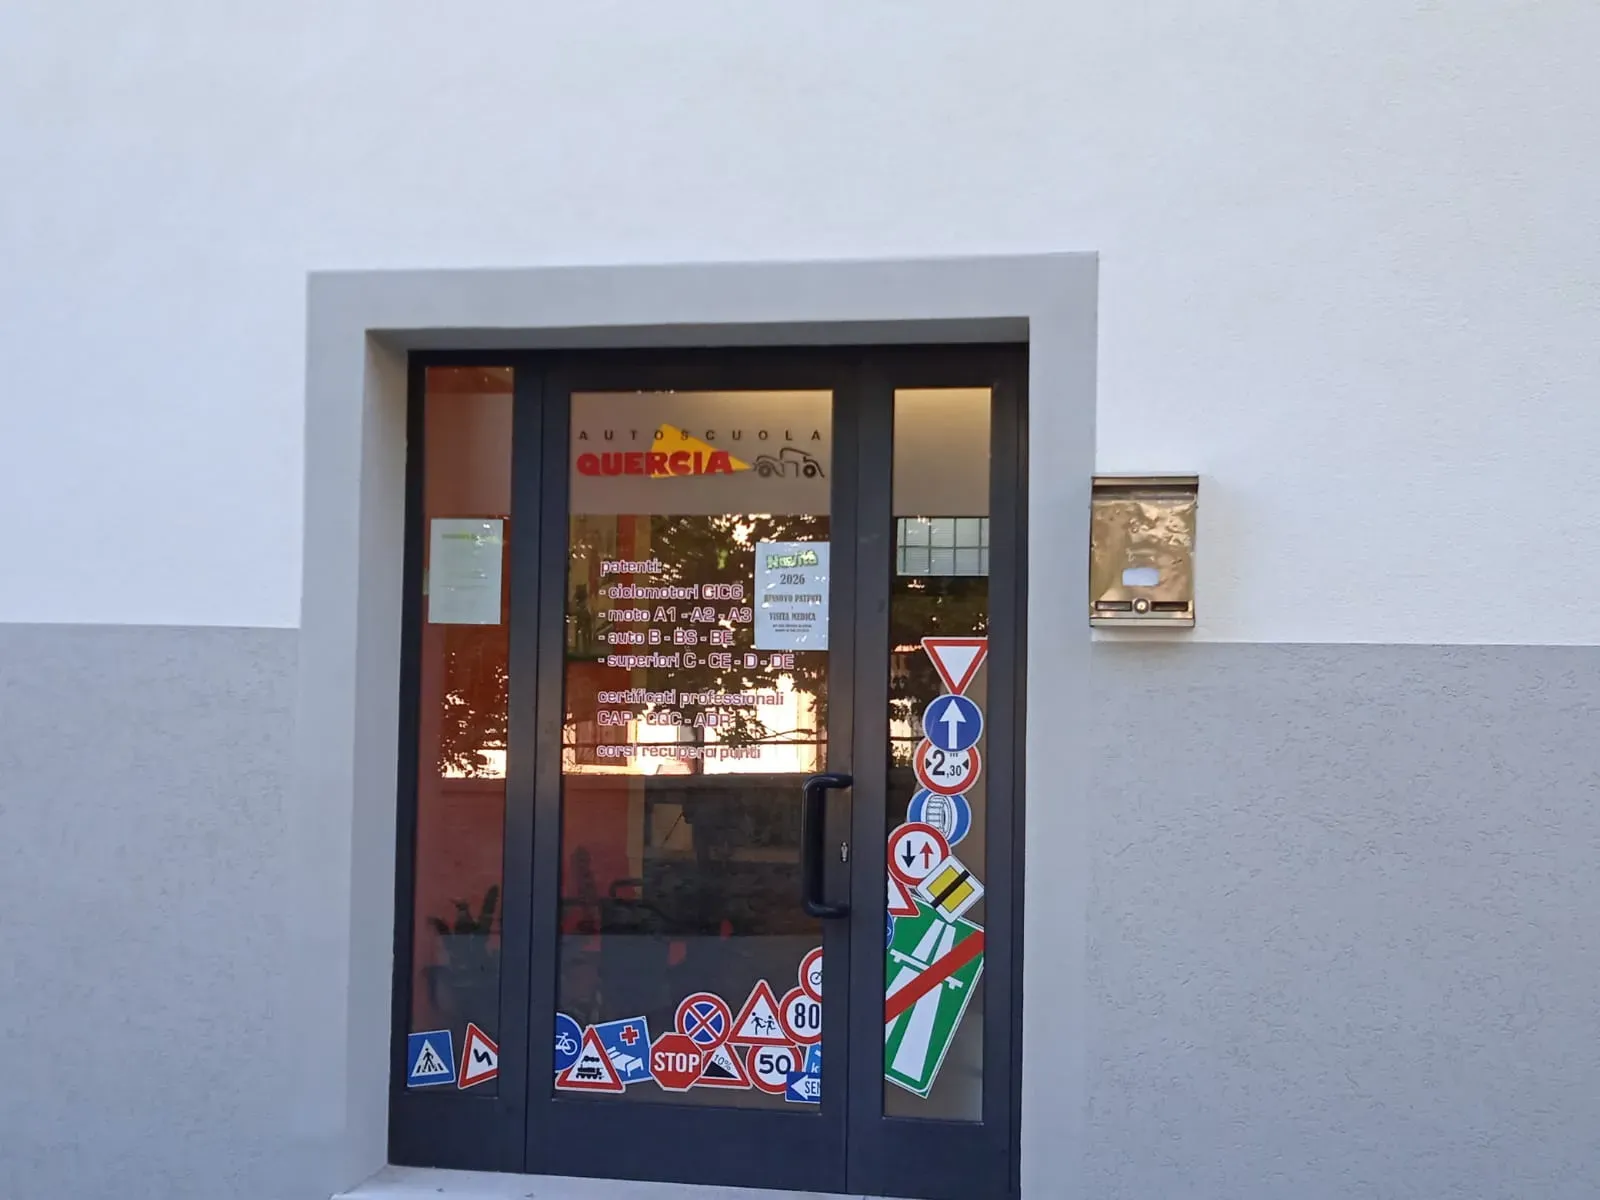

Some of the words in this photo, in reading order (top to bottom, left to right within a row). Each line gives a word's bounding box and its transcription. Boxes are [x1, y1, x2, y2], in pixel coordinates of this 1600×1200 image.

[578, 430, 821, 441] AUTOSCUOLA
[576, 451, 733, 476] QUERCIA
[600, 558, 662, 577] patenti:
[780, 574, 805, 585] 2026
[608, 583, 699, 599] ciclomotori
[608, 608, 650, 621] moto
[653, 606, 676, 622] A1
[690, 607, 715, 623] A2
[728, 607, 752, 623] A3
[608, 631, 644, 644] auto
[648, 629, 661, 644] B
[710, 630, 734, 645] BE
[607, 652, 680, 670] superiori
[683, 653, 696, 668] C
[708, 653, 732, 668] CE
[744, 653, 758, 668] D
[770, 653, 795, 669] DE
[598, 688, 676, 704] certificati
[680, 690, 784, 708] professionali
[598, 710, 633, 726] CAP
[646, 711, 682, 726] CQC
[693, 712, 731, 727] ADR
[597, 745, 637, 758] corsi
[642, 747, 714, 761] recupero
[720, 746, 761, 761] punti
[794, 1003, 820, 1029] 80
[654, 1052, 700, 1073] STOP
[714, 1054, 732, 1071] 10%
[759, 1054, 791, 1075] 50
